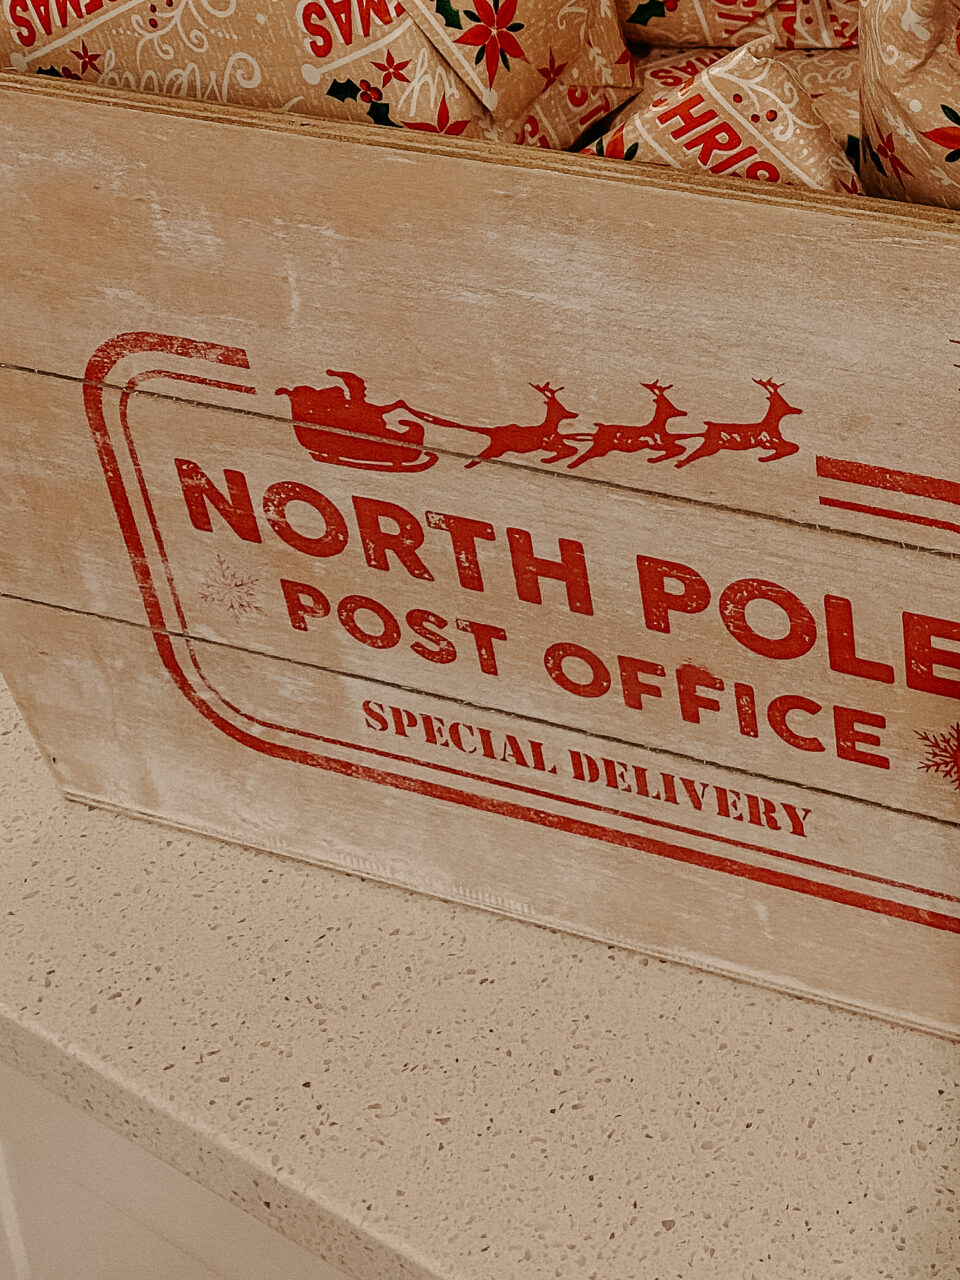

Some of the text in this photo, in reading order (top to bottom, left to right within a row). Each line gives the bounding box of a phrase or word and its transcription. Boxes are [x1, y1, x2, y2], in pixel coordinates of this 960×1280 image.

[174, 457, 594, 617] NORTH
[279, 578, 890, 770] POST OFFICE
[362, 699, 813, 838] SPECIAL DELIVERY
